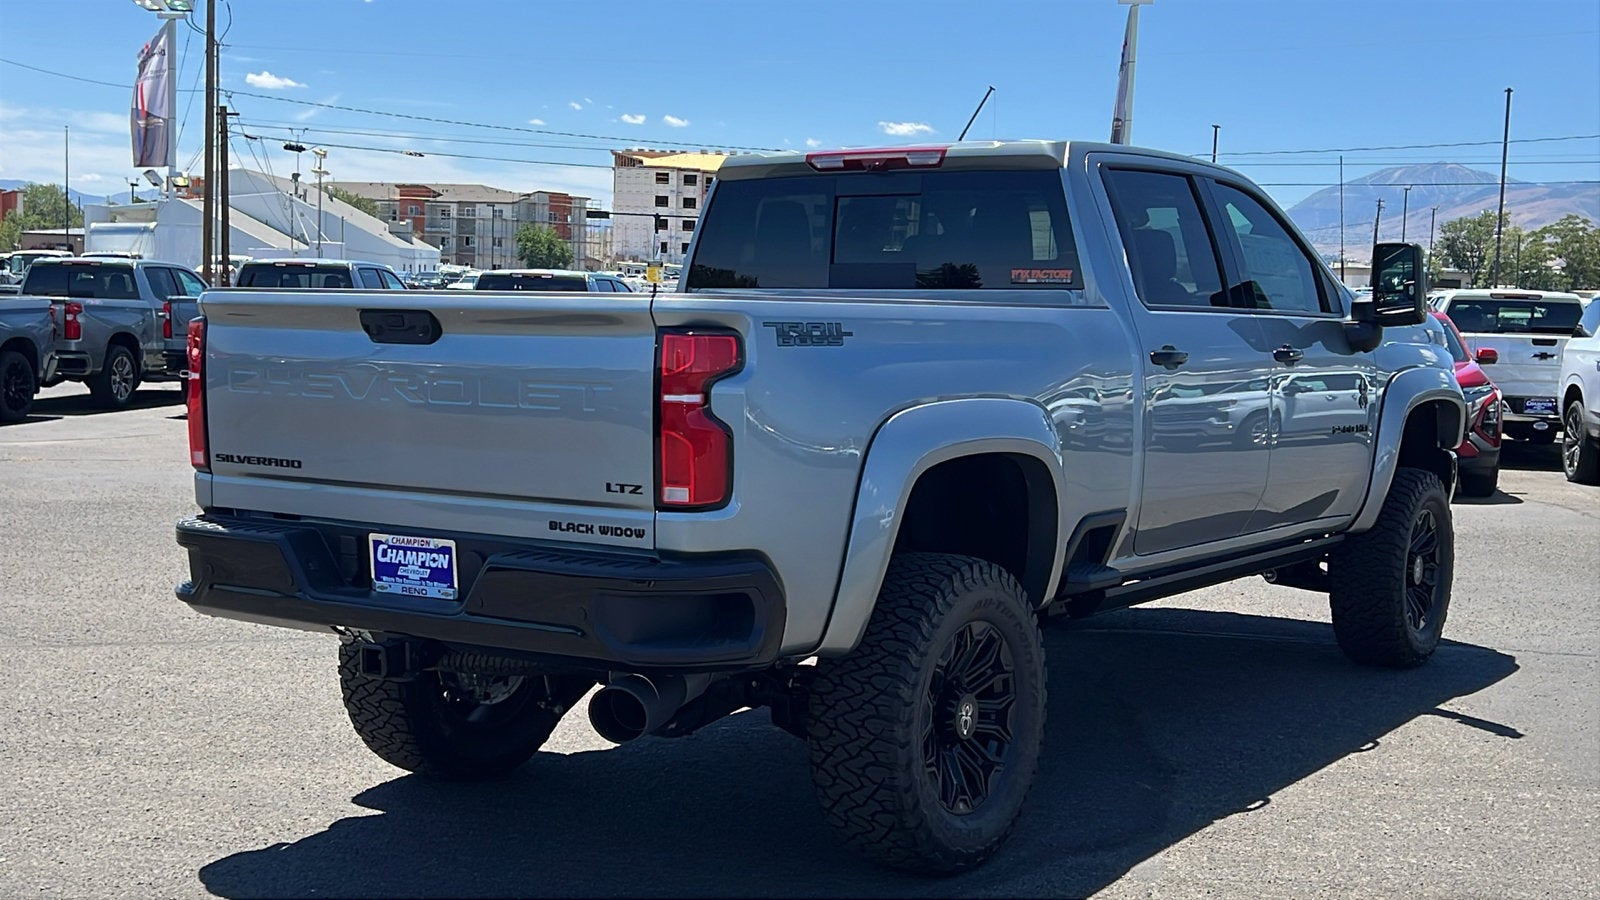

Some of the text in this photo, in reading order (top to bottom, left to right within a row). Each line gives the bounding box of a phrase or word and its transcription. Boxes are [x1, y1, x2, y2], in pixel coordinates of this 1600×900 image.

[1031, 269, 1073, 279] FACTORY
[762, 321, 854, 337] TRAIL
[777, 335, 844, 347] BOSS
[227, 365, 614, 412] CHEVROLET
[215, 453, 302, 469] SILVERADO
[605, 482, 643, 495] LTZ
[548, 520, 646, 539] BLACK WIDOW
[391, 536, 431, 547] CHAMPION
[376, 543, 450, 569] CHAMPION
[399, 567, 429, 577] CHEVROLET
[401, 586, 428, 596] RENO
